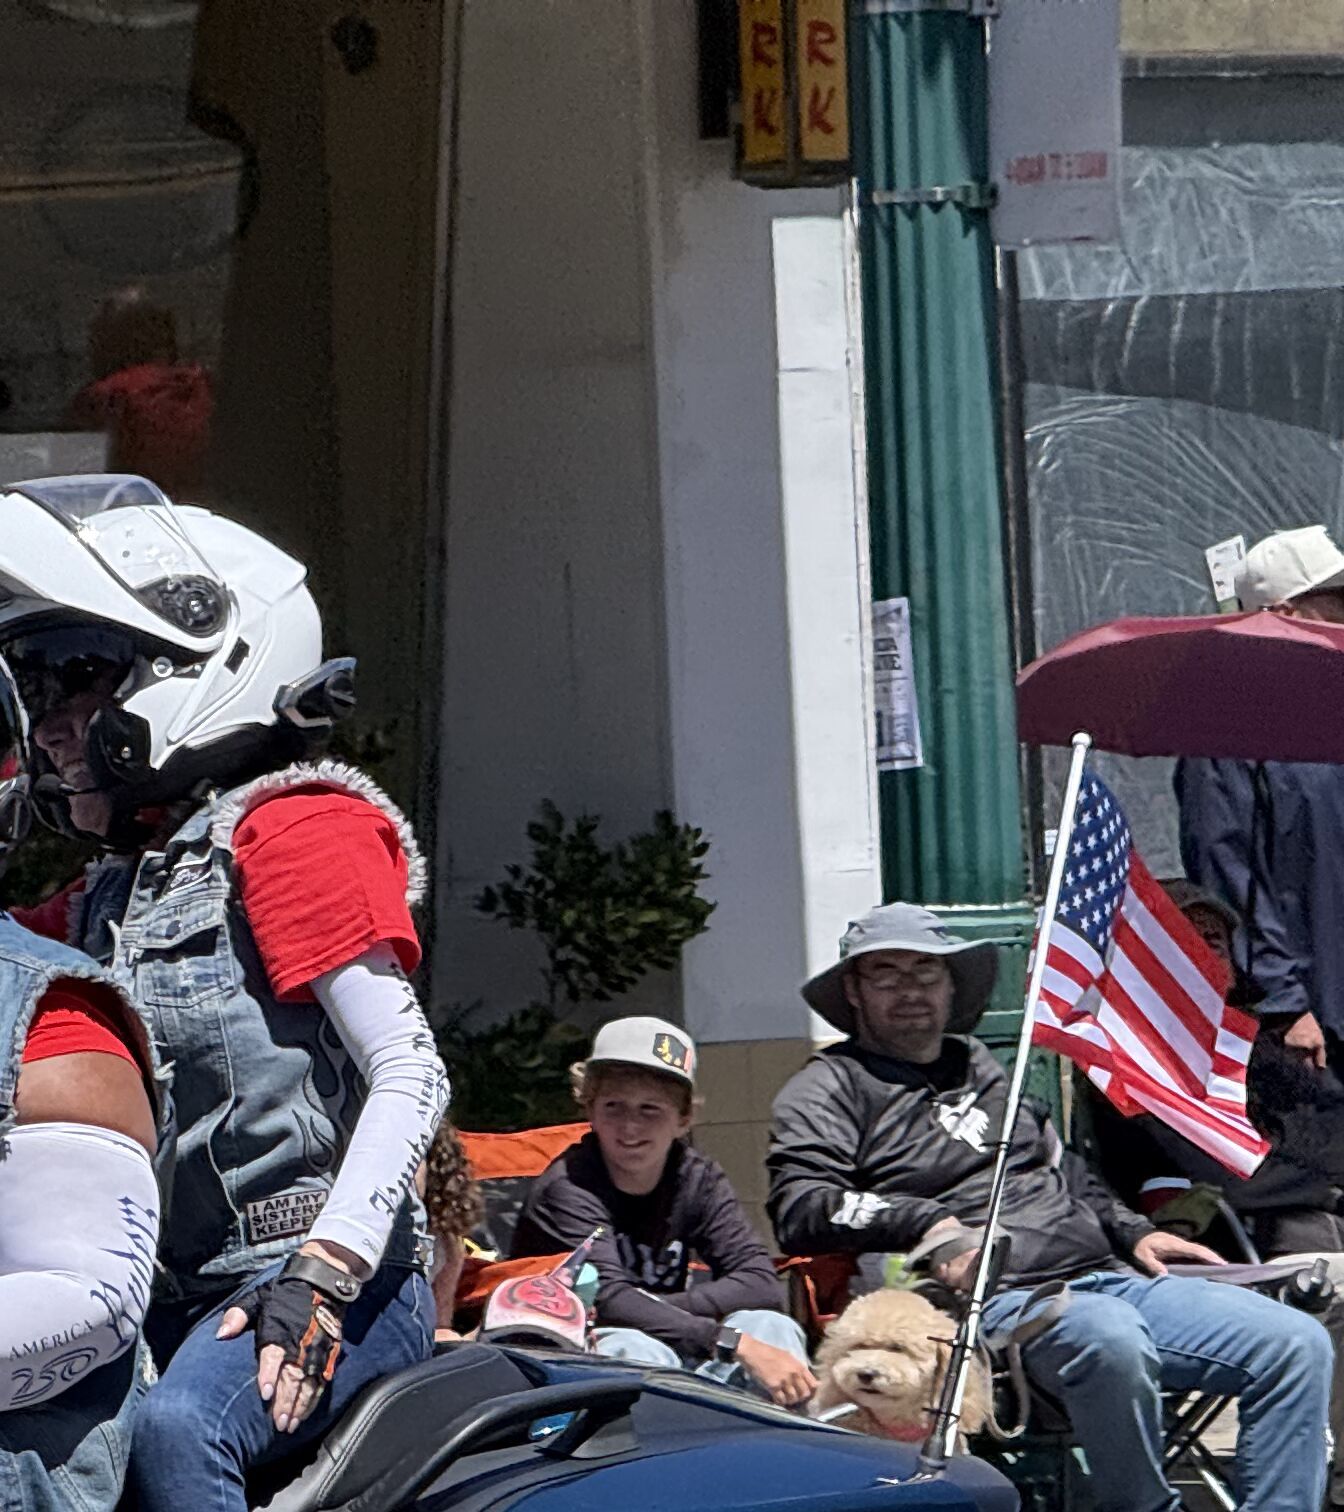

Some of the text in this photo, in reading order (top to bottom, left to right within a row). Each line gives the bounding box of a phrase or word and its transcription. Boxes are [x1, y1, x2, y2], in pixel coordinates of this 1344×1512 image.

[252, 1192, 322, 1215] I AM MY
[252, 1203, 323, 1227] SISTERS
[9, 1318, 94, 1361] AMERICA
[9, 1346, 100, 1407] 250
